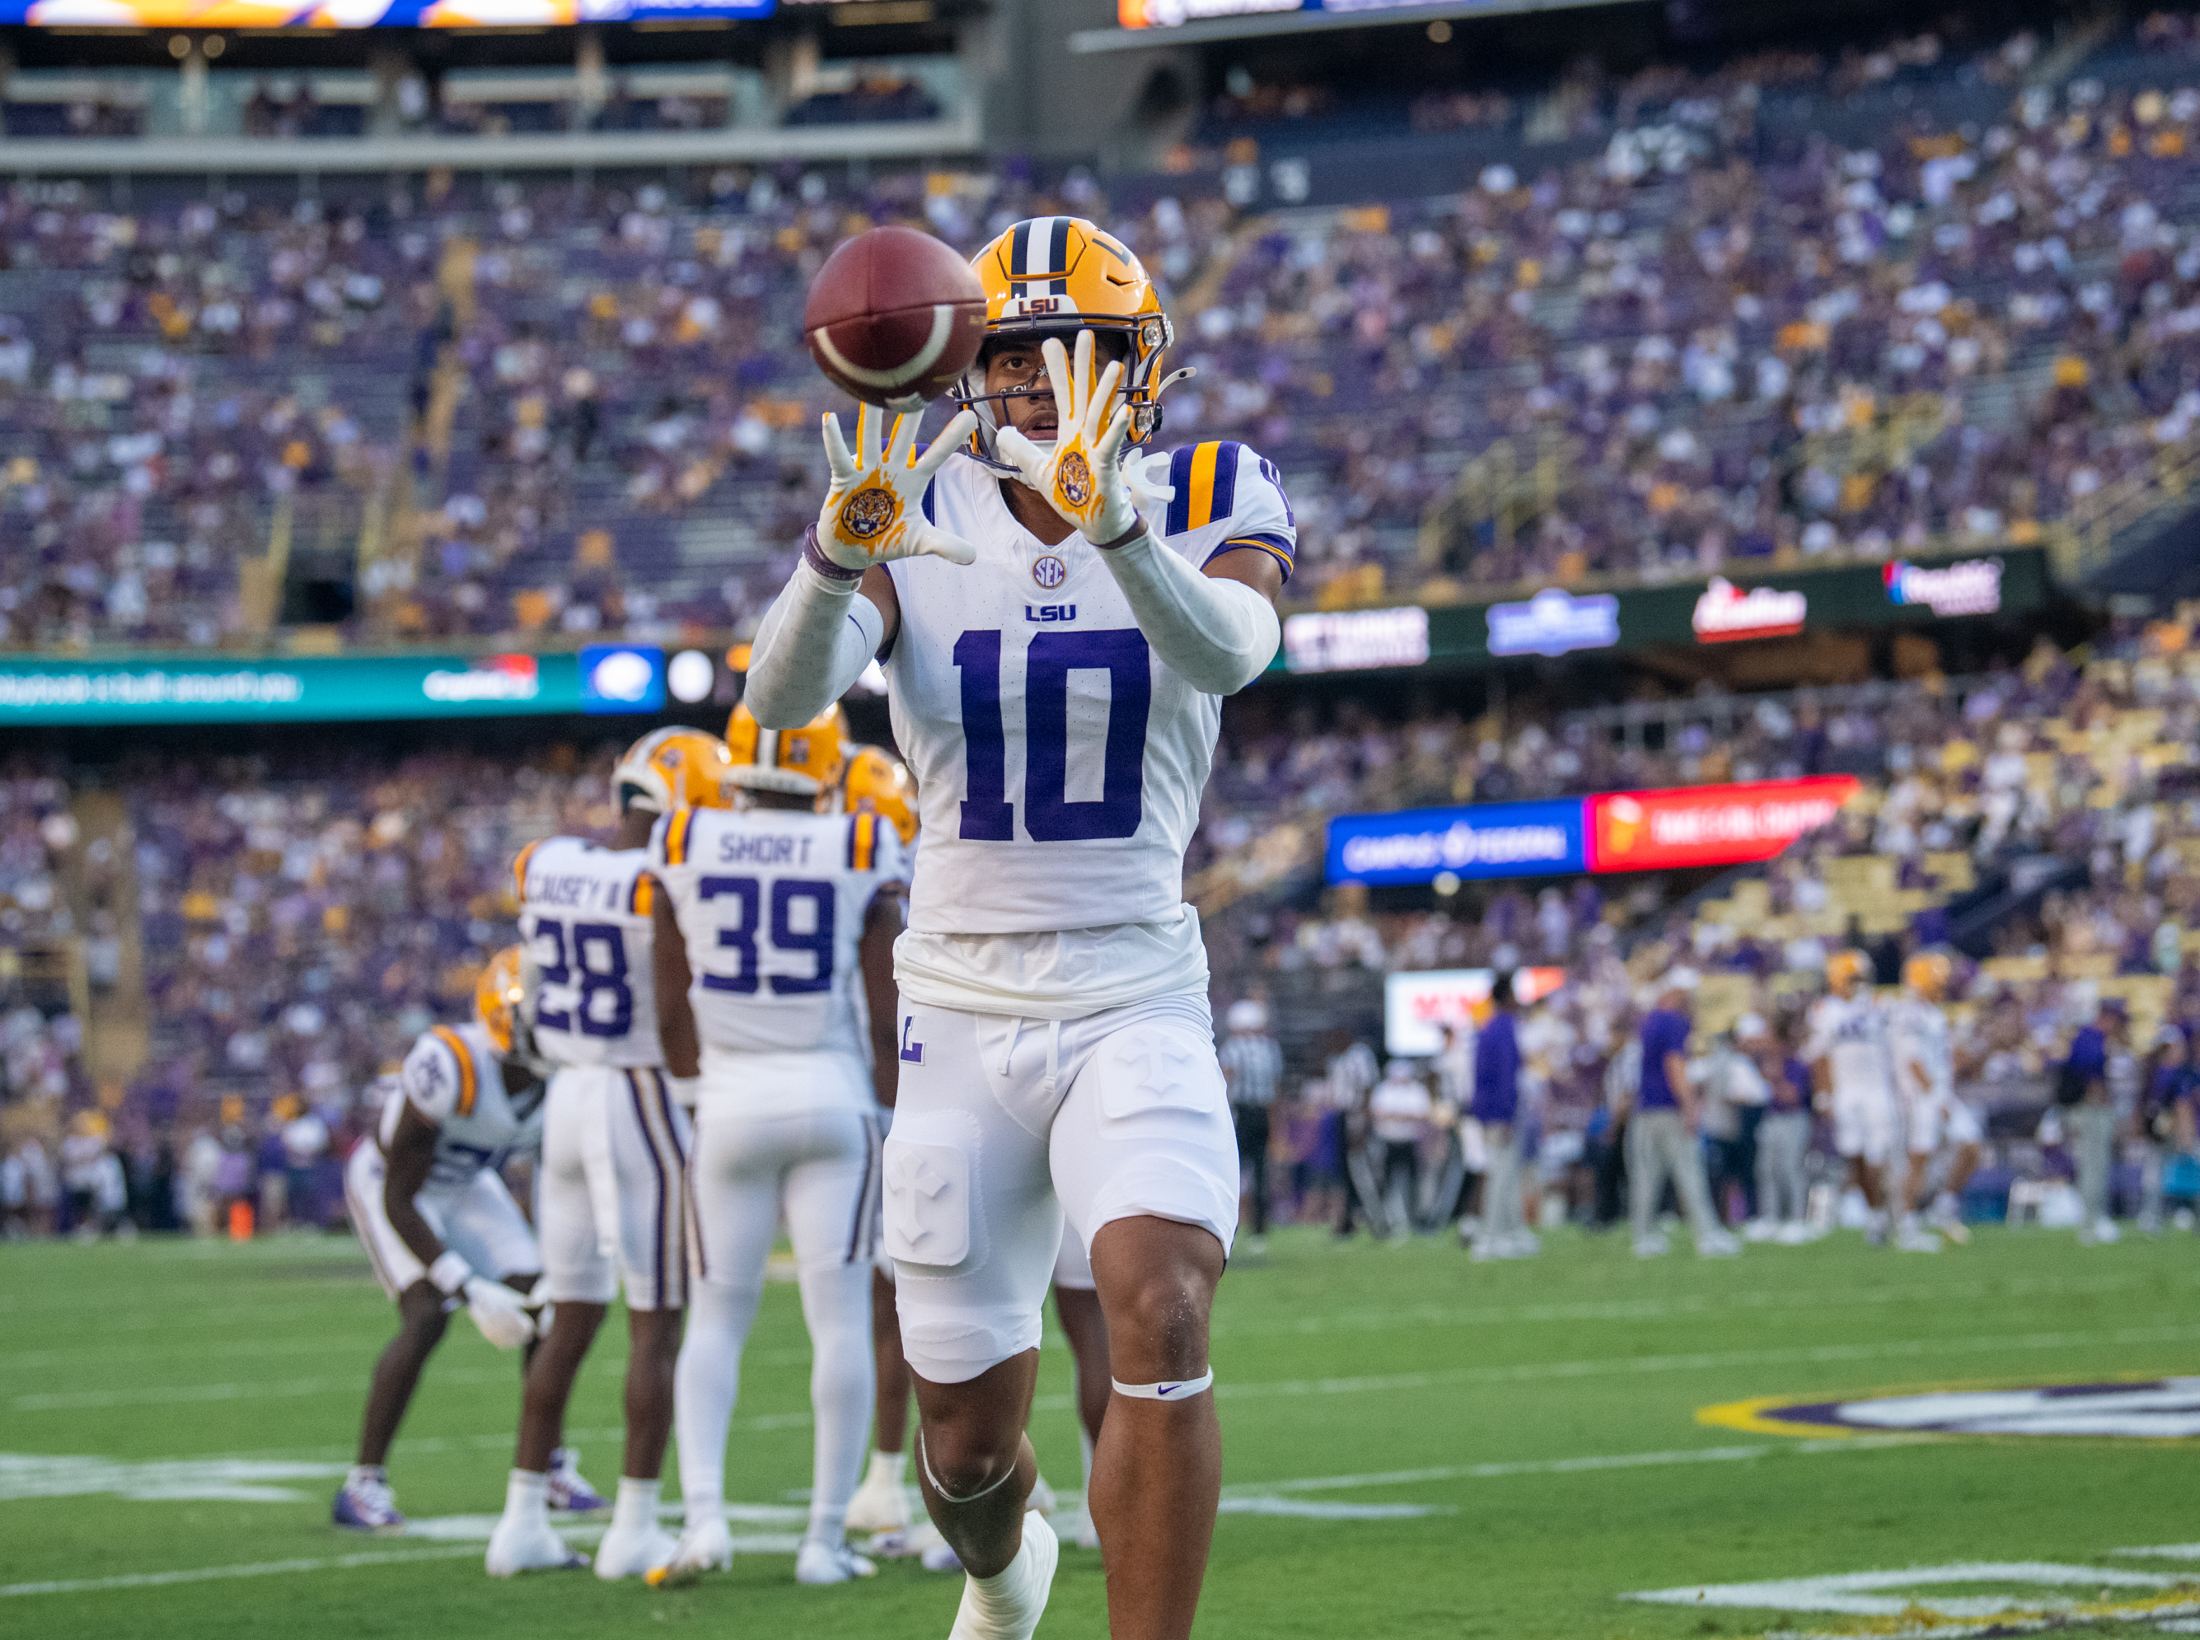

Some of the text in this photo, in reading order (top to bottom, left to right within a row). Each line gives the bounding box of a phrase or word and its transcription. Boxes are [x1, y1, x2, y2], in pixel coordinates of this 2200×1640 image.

[1018, 297, 1059, 315] LSU
[1035, 558, 1064, 587] SEC
[1025, 604, 1077, 622] LSU
[952, 627, 1151, 842] 10
[720, 832, 813, 865] SHORT
[699, 876, 836, 996] 39
[535, 917, 633, 1037] 28
